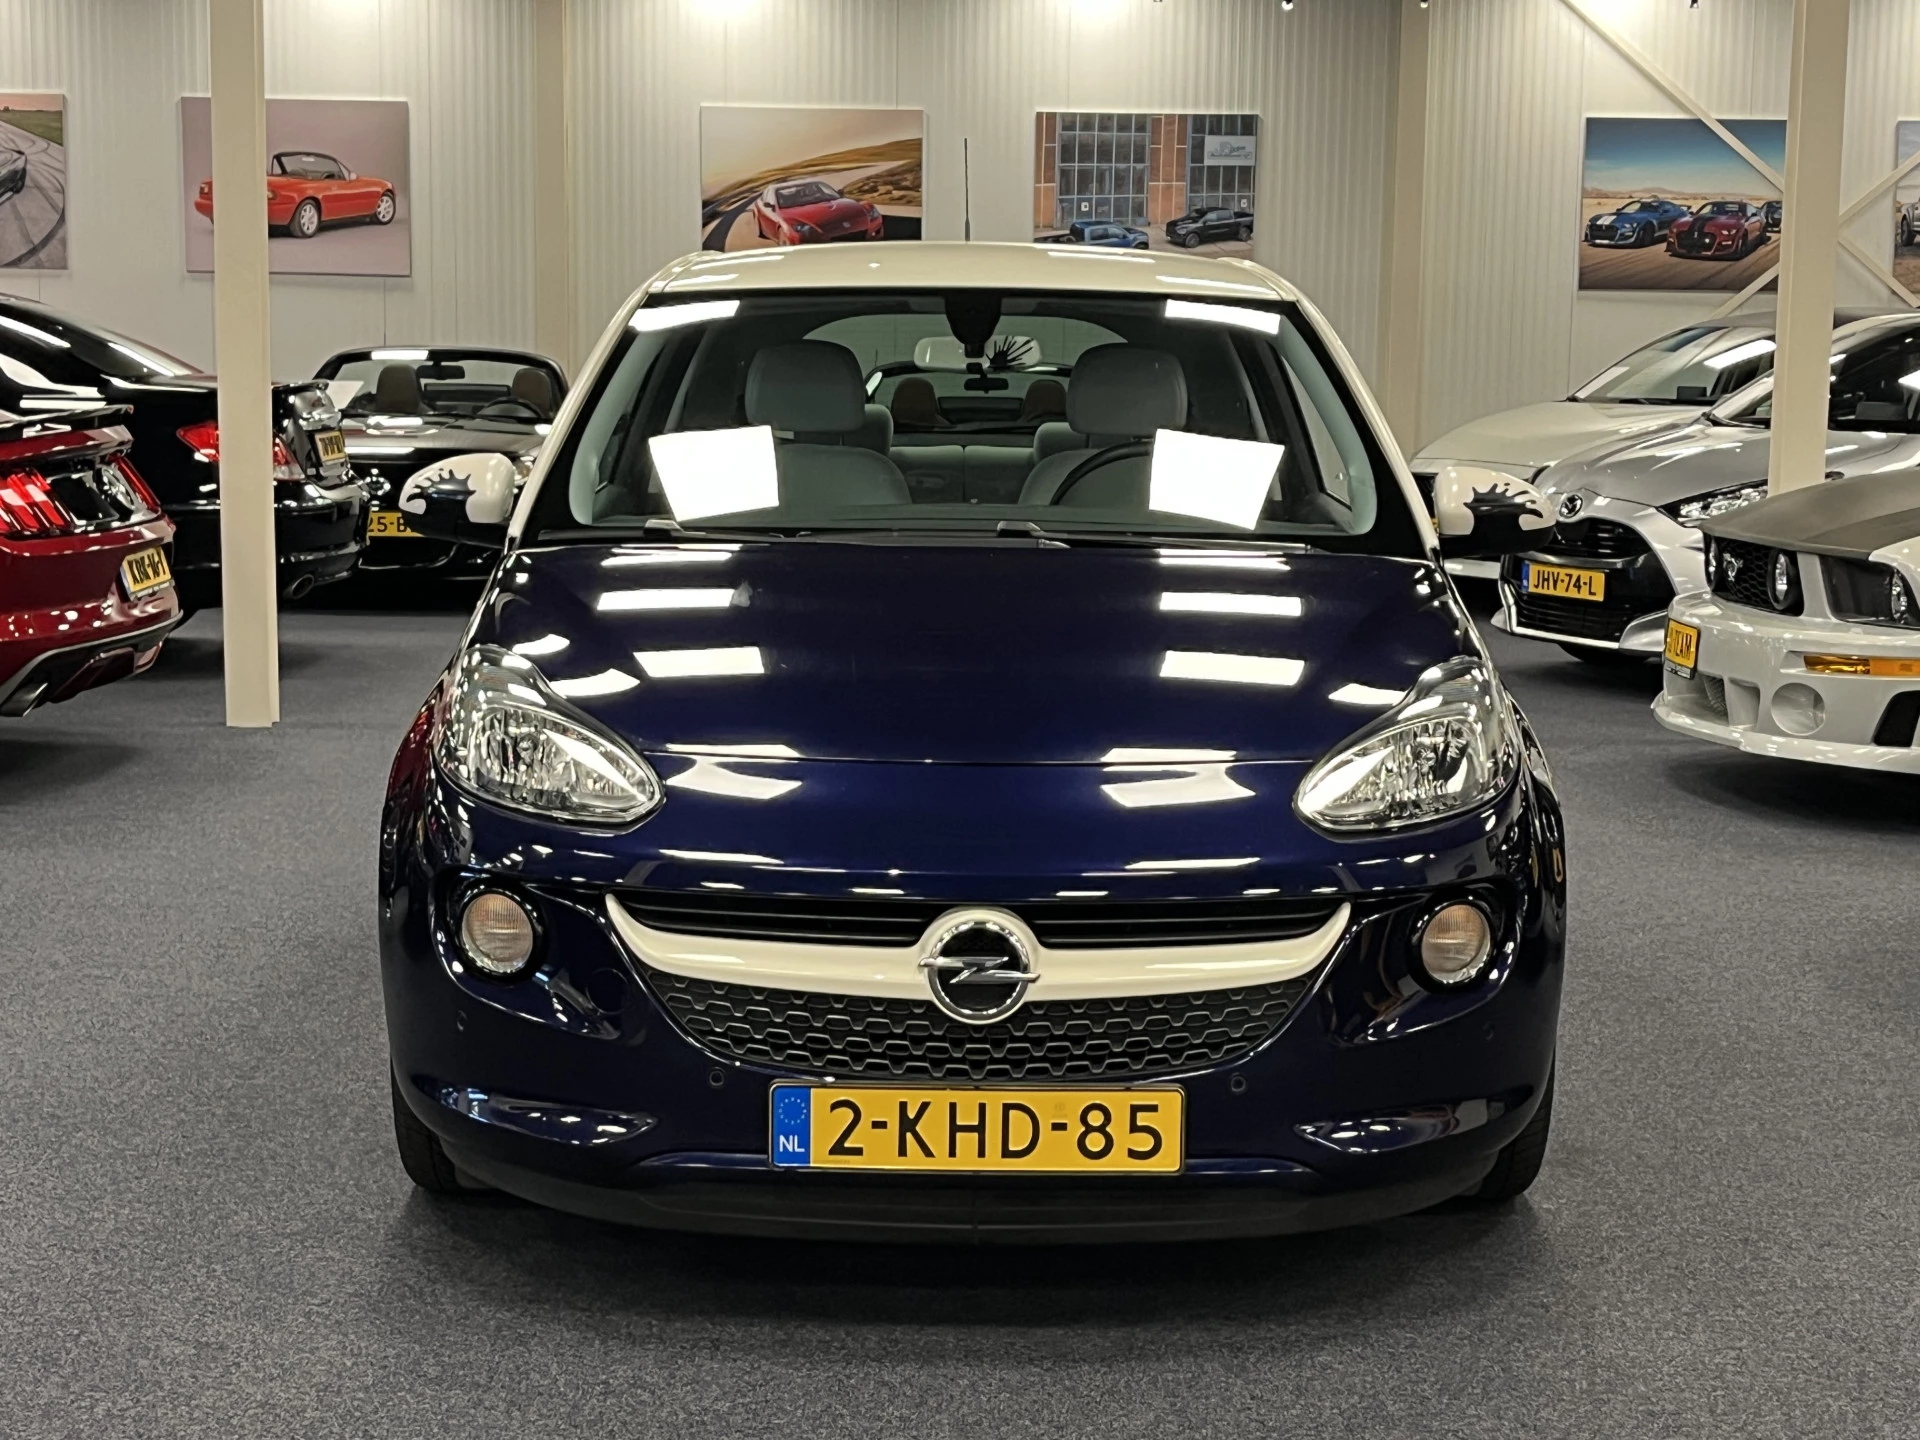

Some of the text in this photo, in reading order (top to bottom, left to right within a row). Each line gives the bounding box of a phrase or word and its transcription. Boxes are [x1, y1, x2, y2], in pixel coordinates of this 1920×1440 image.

[1533, 569, 1597, 596] JHV-74-L
[779, 1098, 1164, 1161] NL 2-KHD-85
